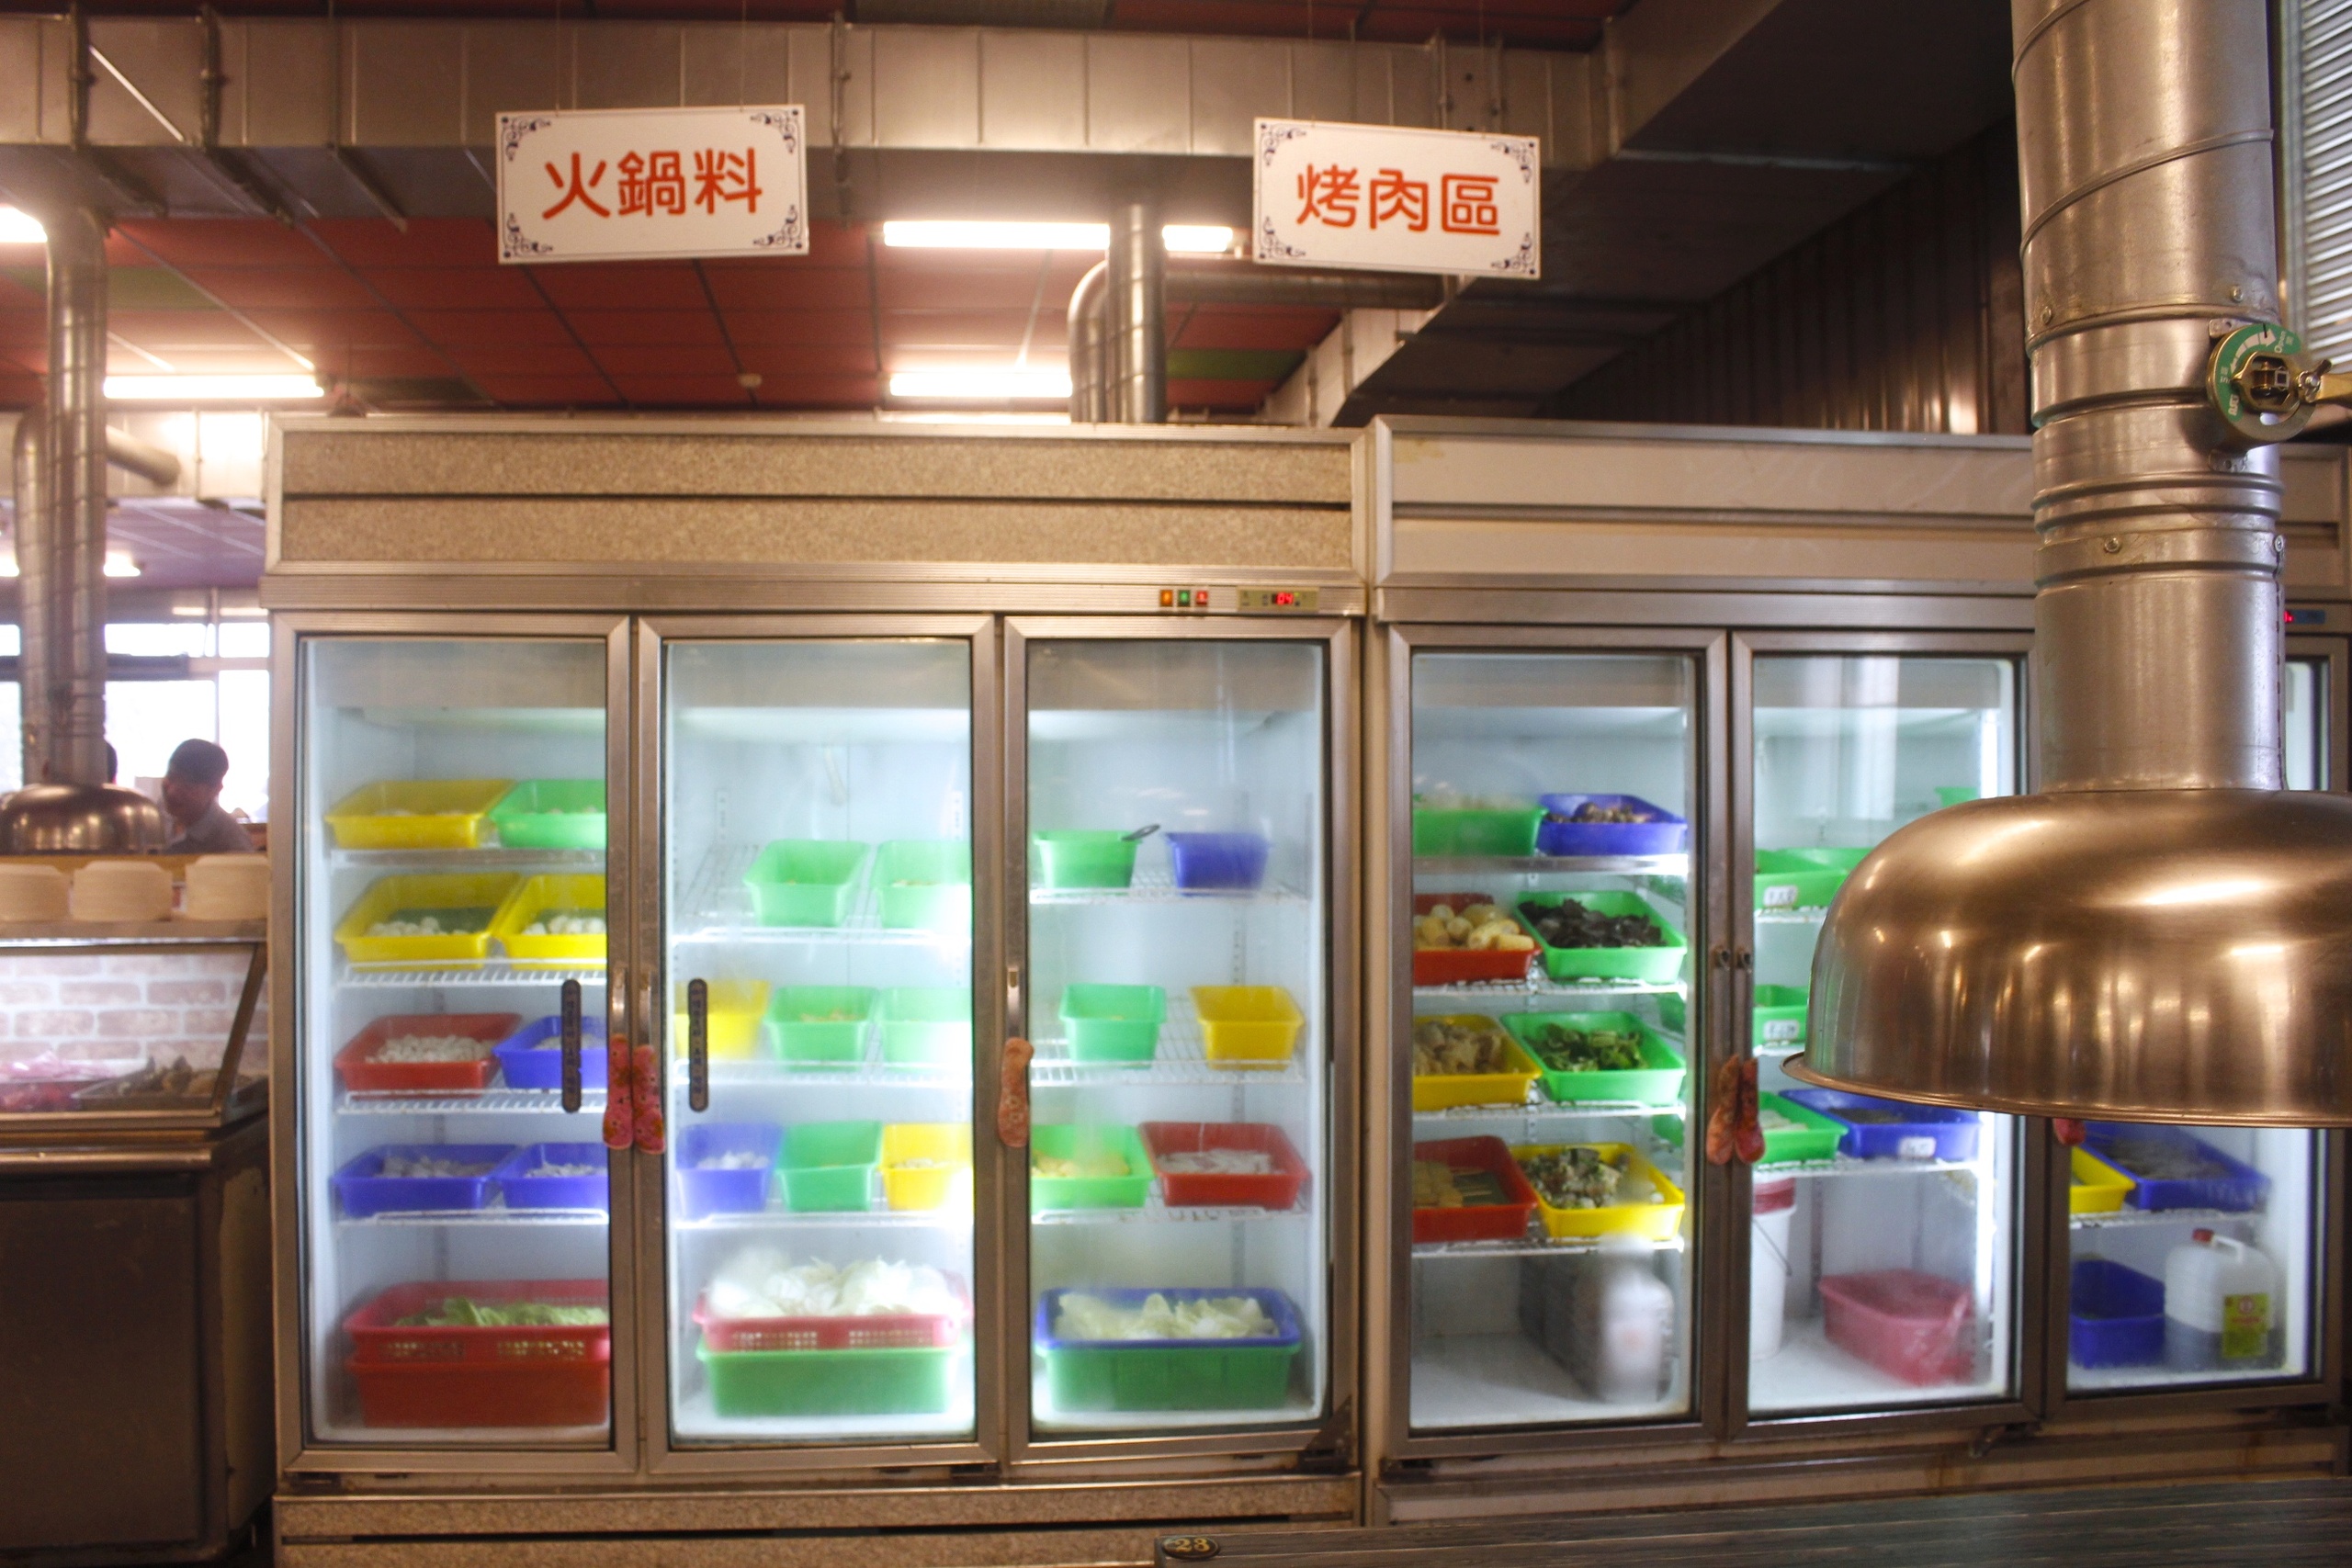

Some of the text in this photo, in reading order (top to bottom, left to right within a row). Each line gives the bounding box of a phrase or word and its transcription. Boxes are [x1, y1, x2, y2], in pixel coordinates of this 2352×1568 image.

[542, 147, 763, 220] 火鍋料
[1296, 164, 1501, 236] 烤肉區
